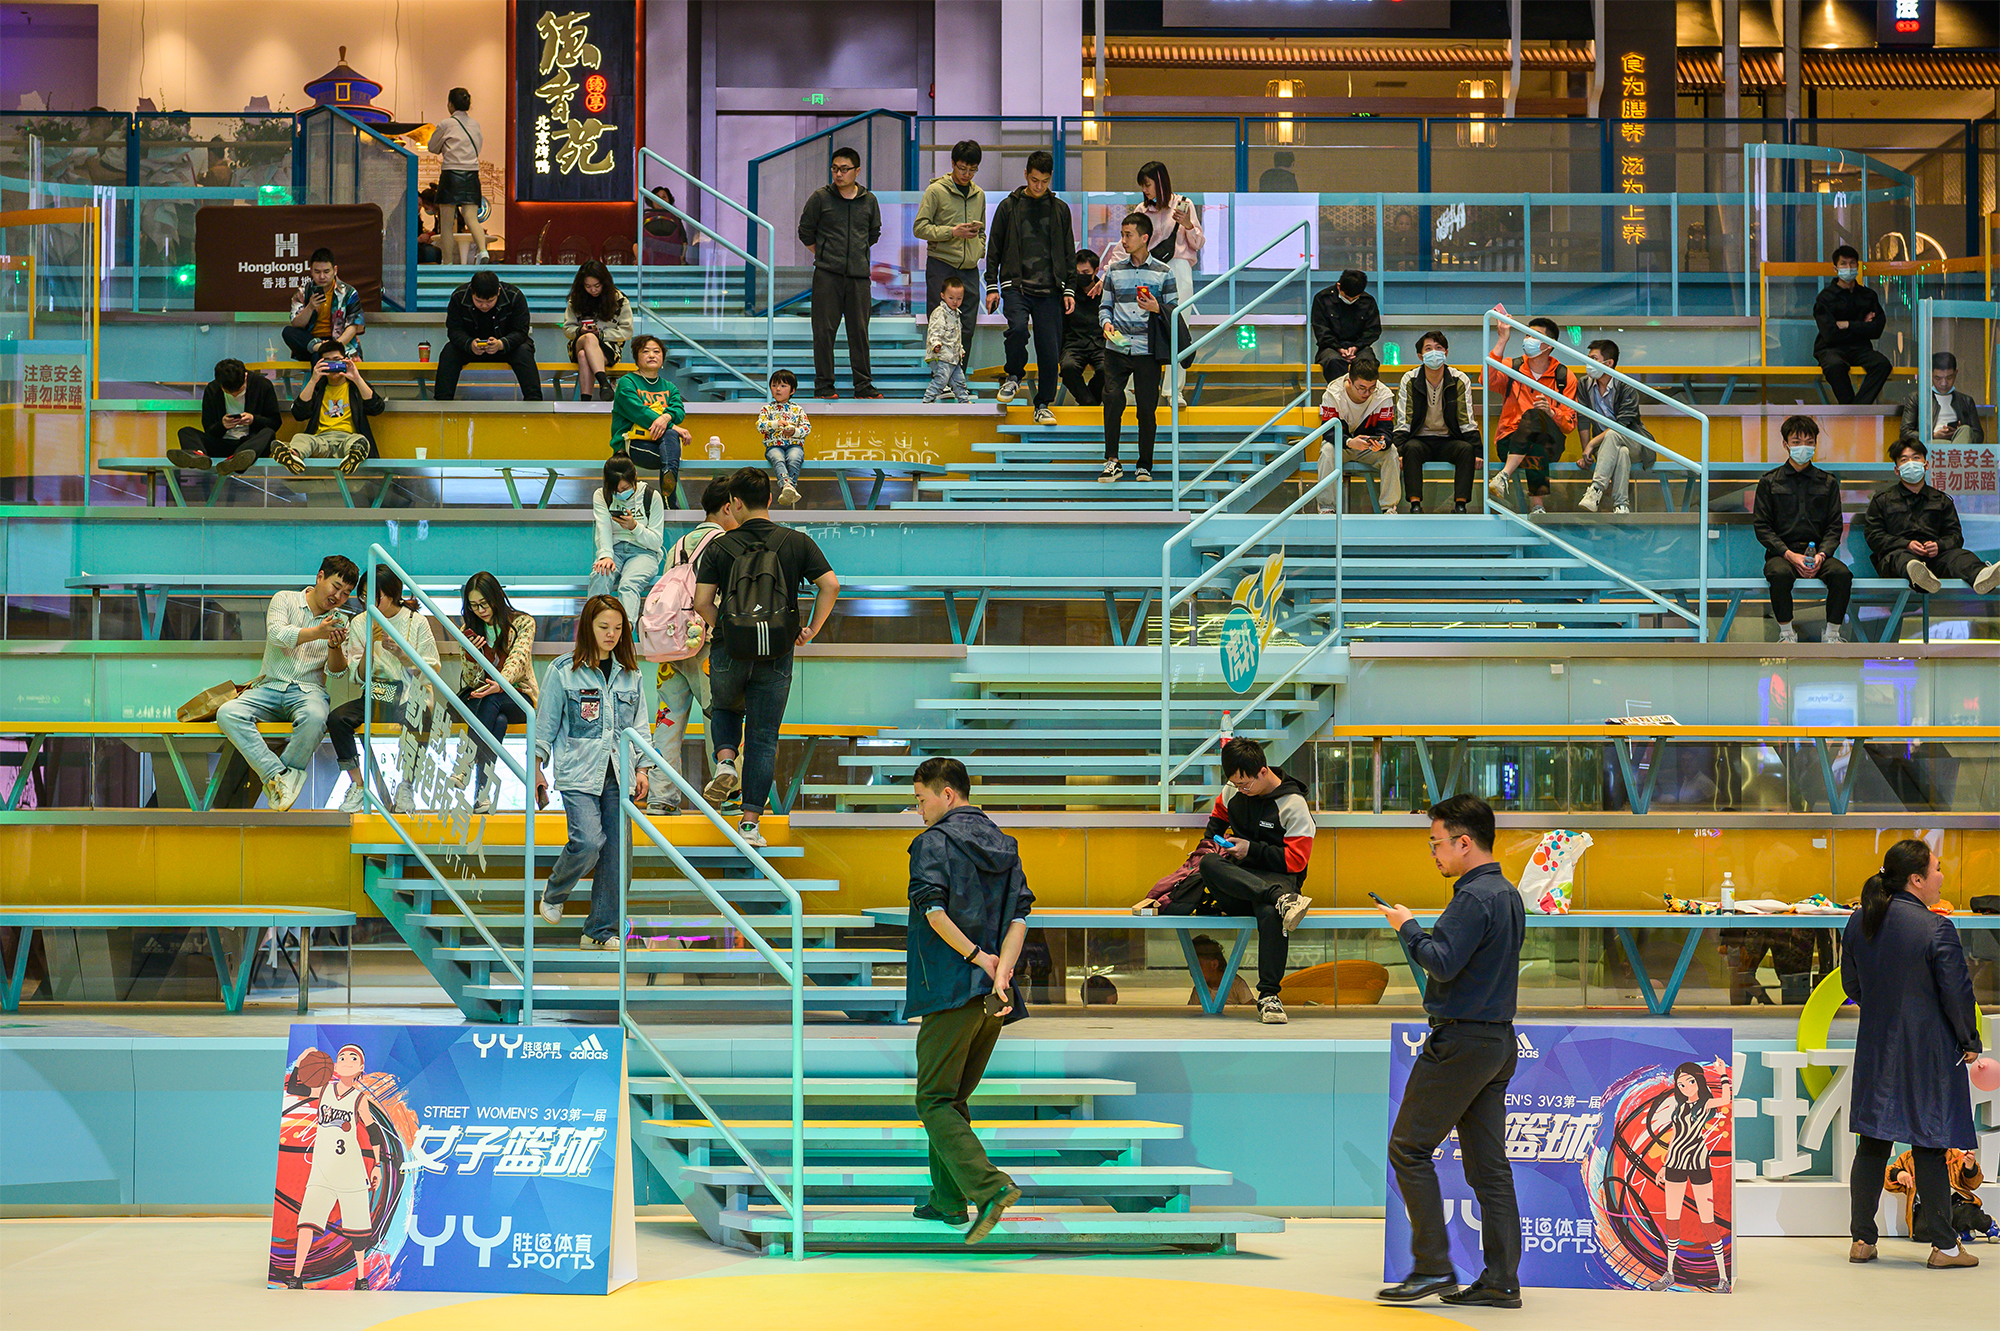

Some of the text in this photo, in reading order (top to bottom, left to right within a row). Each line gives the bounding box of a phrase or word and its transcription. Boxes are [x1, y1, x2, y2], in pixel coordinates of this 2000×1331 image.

[535, 115, 550, 174] 北京烤鸭
[24, 364, 83, 383] 注意安全
[24, 384, 83, 406] 请勿踩踏
[1931, 448, 1995, 469] 注意安全
[1931, 470, 1996, 491] 请勿踩踏
[473, 1033, 609, 1060] YY adidas
[1402, 1032, 1539, 1059] Y das
[1504, 1093, 1532, 1106] EN'S
[423, 1106, 470, 1119] STREET
[477, 1107, 538, 1120] WOMEN'S
[335, 1139, 346, 1155] 3
[1504, 1112, 1603, 1163] 篮球
[399, 1125, 607, 1177] 女子篮球
[408, 1215, 512, 1268] YY
[1524, 1237, 1598, 1254] PORTS
